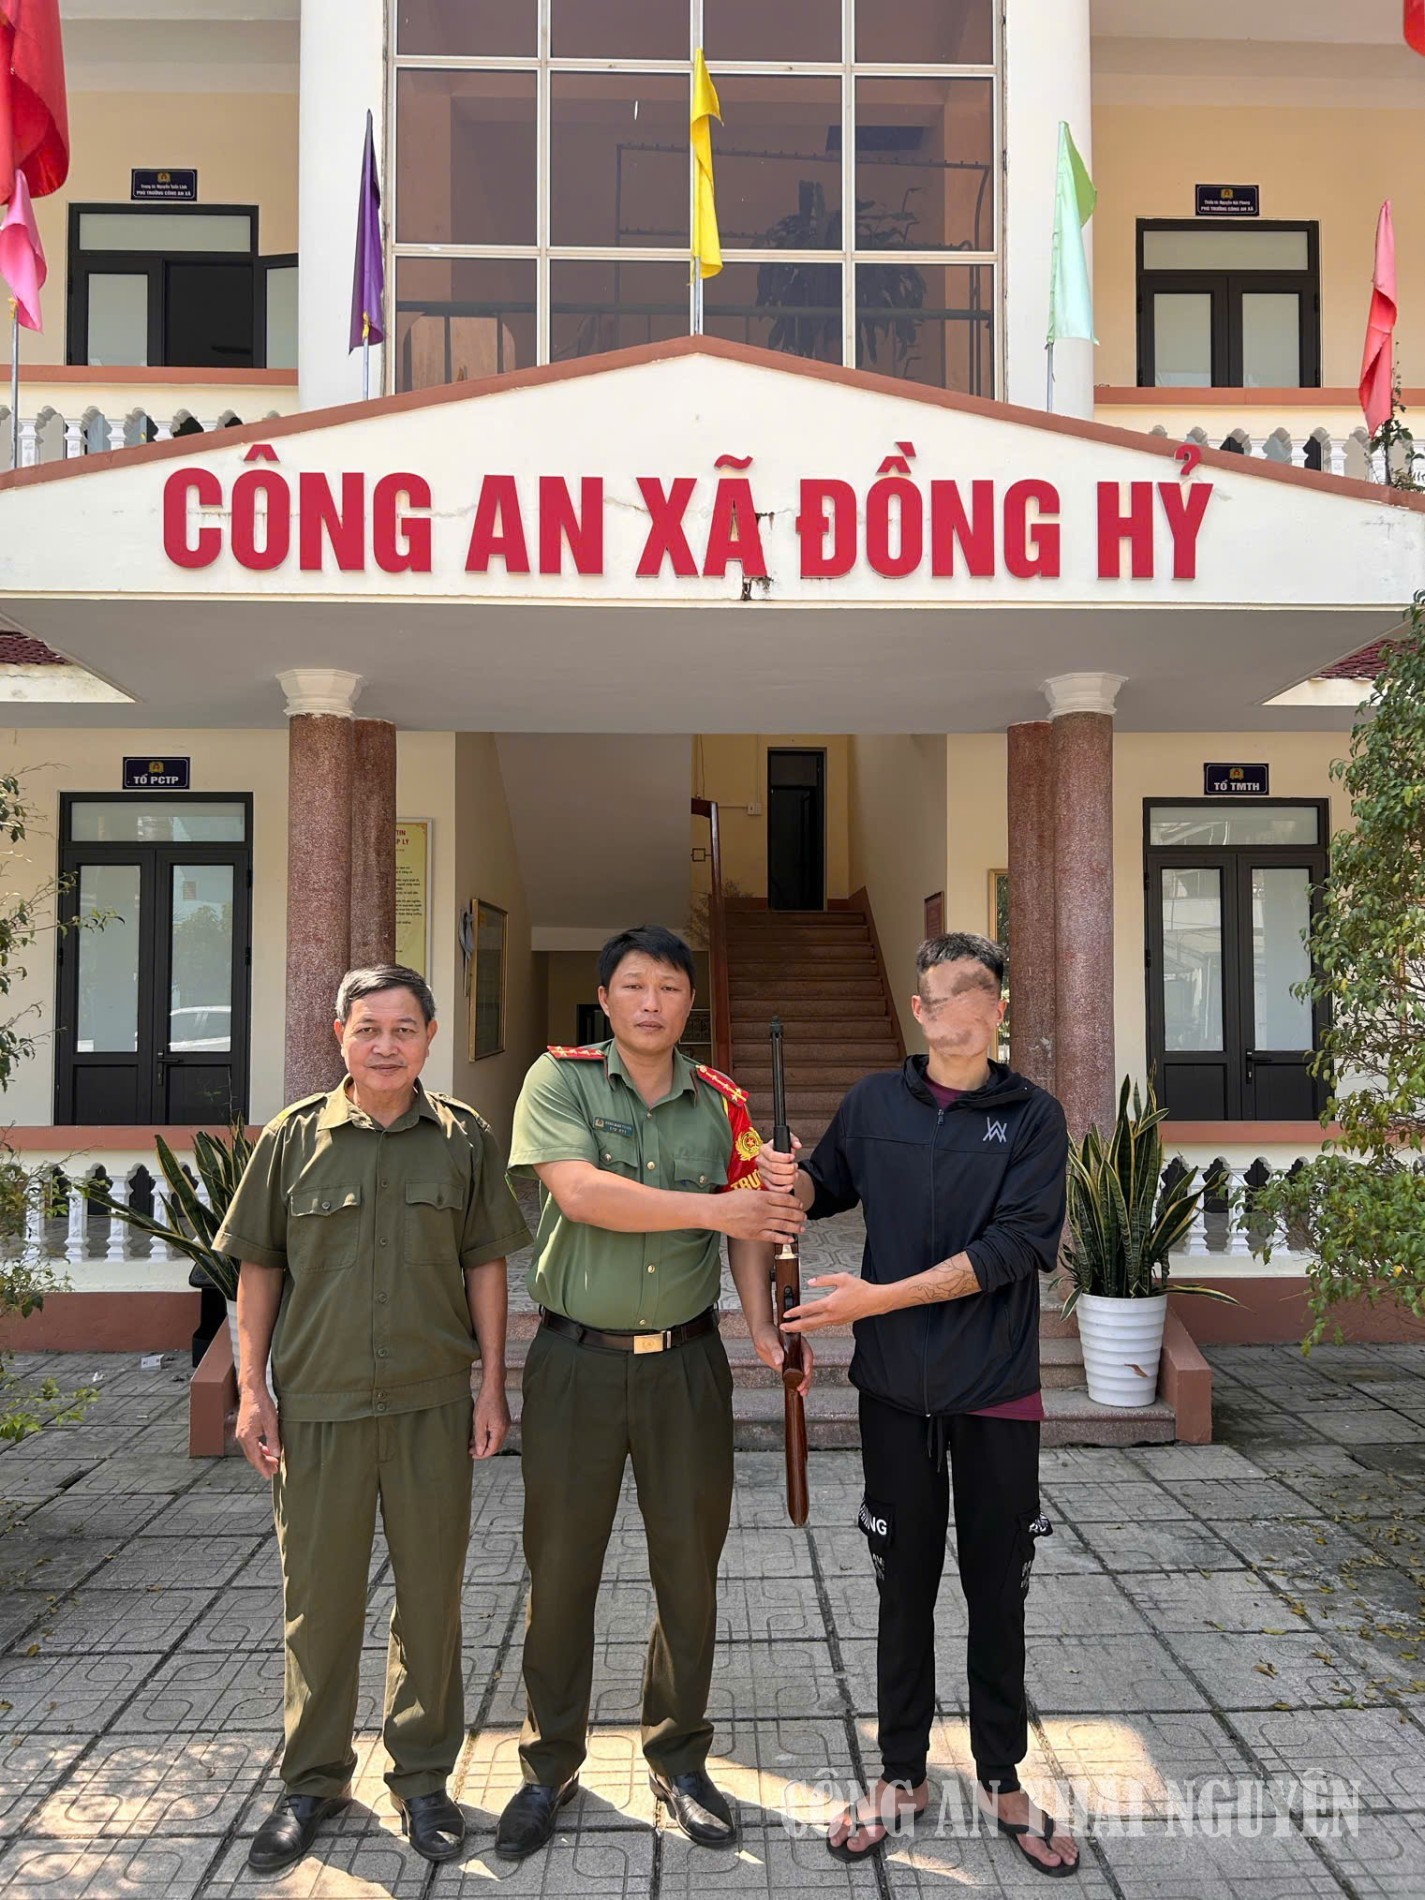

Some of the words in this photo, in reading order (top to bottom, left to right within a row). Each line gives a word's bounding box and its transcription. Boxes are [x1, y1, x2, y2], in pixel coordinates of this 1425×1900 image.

[163, 444, 433, 573] CÔNG
[465, 474, 604, 576] AN
[635, 455, 769, 579] XÃ
[796, 441, 1061, 579] ĐỒNG
[1096, 443, 1214, 580] HỶ
[150, 776, 179, 785] PCTP
[1230, 782, 1260, 791] TMTH
